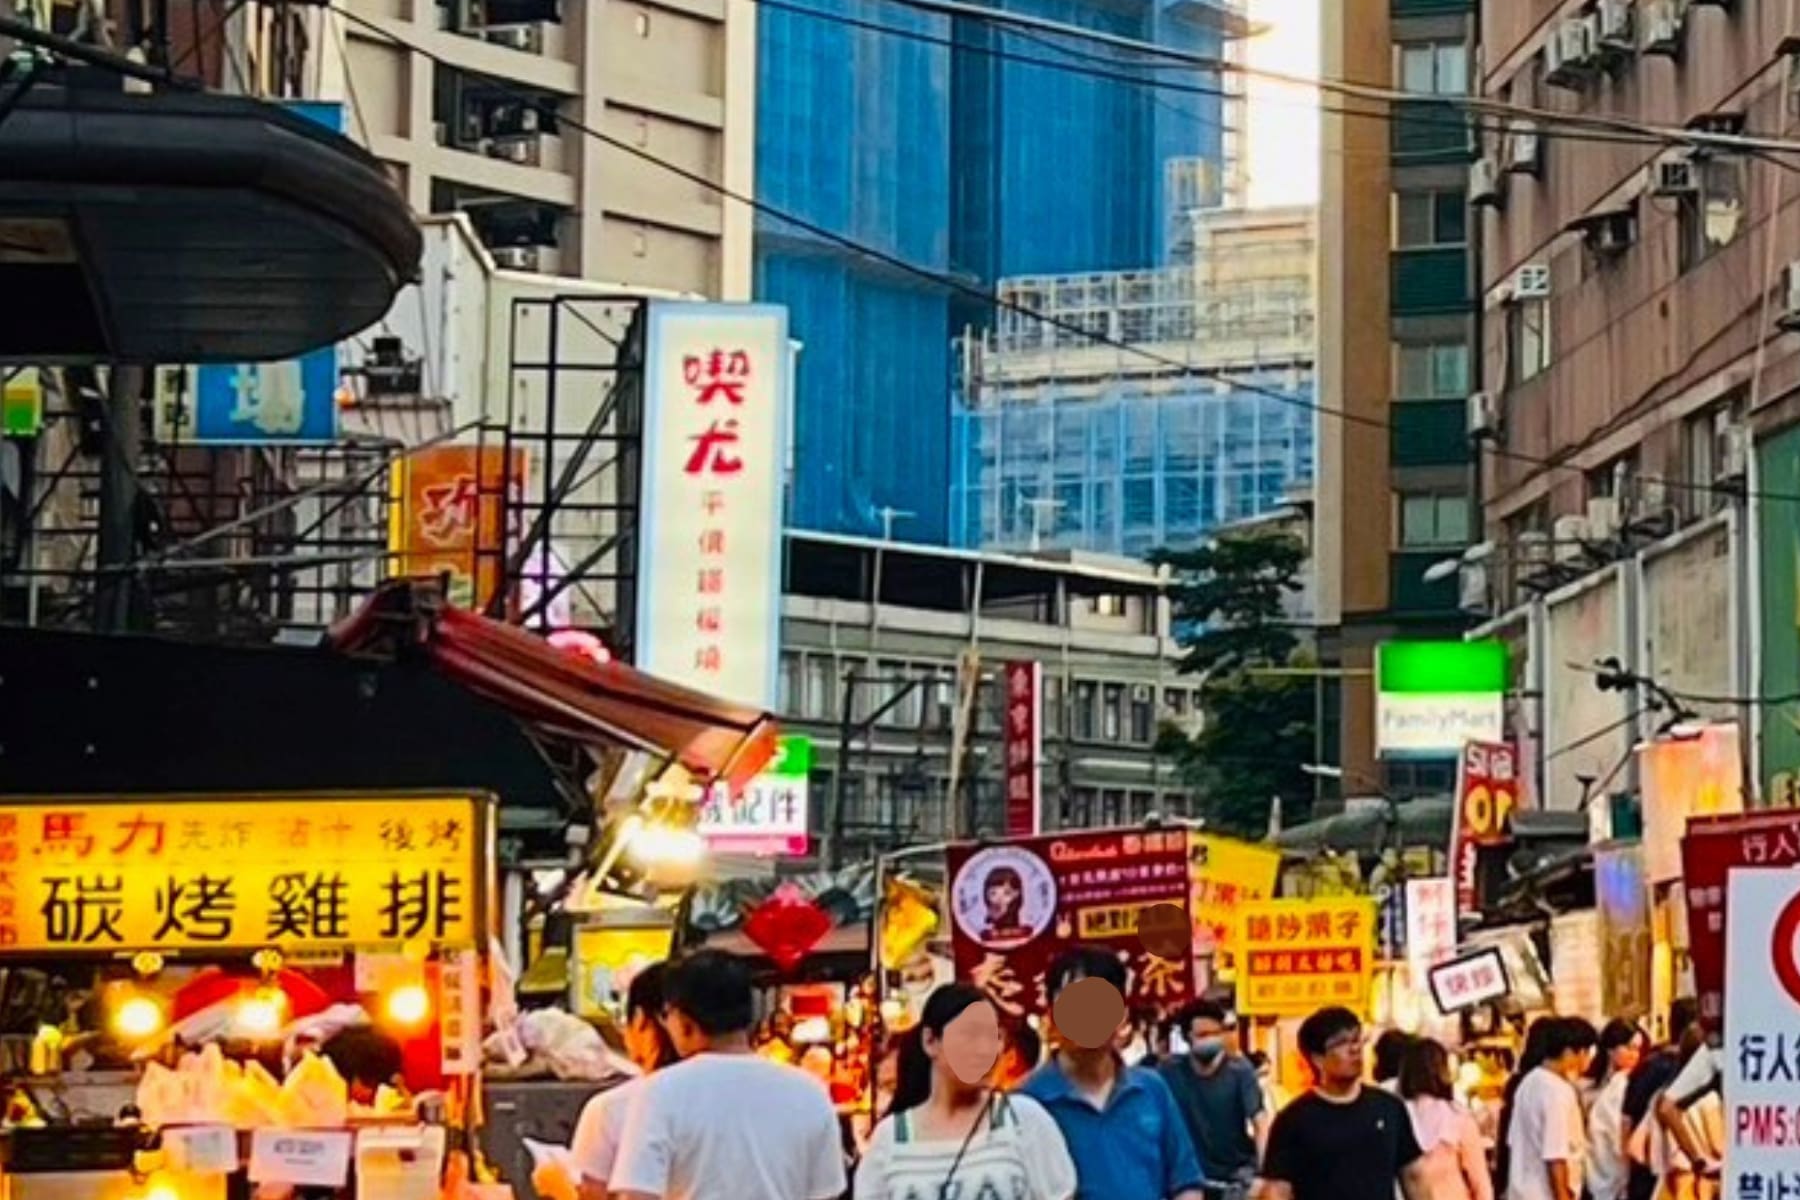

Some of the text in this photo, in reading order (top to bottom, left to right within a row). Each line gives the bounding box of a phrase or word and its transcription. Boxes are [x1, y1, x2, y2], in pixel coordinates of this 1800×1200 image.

[1383, 707, 1495, 729] FamilyMart
[32, 811, 165, 857] 馬力
[41, 871, 462, 943] 碳烤雞排
